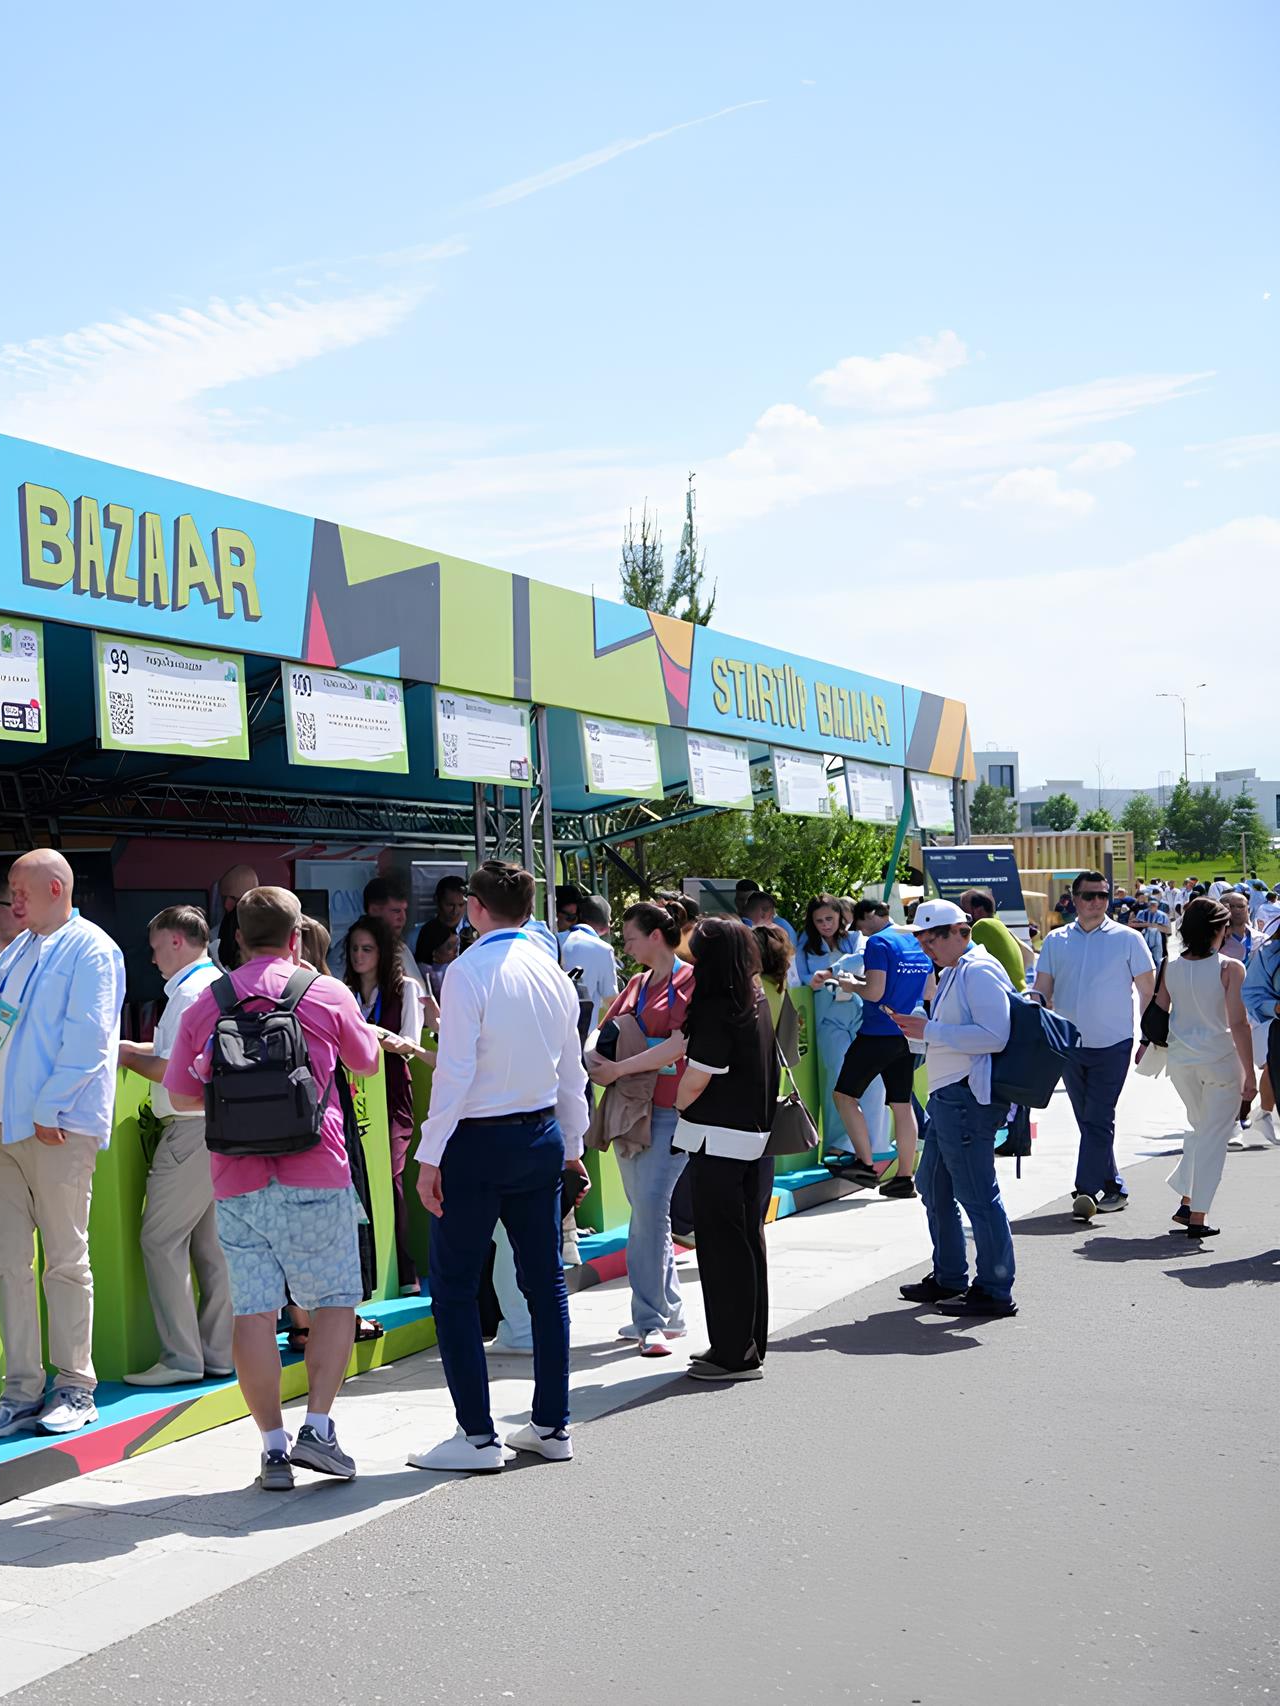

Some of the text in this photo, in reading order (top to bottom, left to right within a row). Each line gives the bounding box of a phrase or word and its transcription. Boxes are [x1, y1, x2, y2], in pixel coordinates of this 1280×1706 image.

[18, 481, 263, 622] BAZAAR
[110, 648, 129, 675] 99
[712, 657, 891, 746] STARTUP BAZAAR
